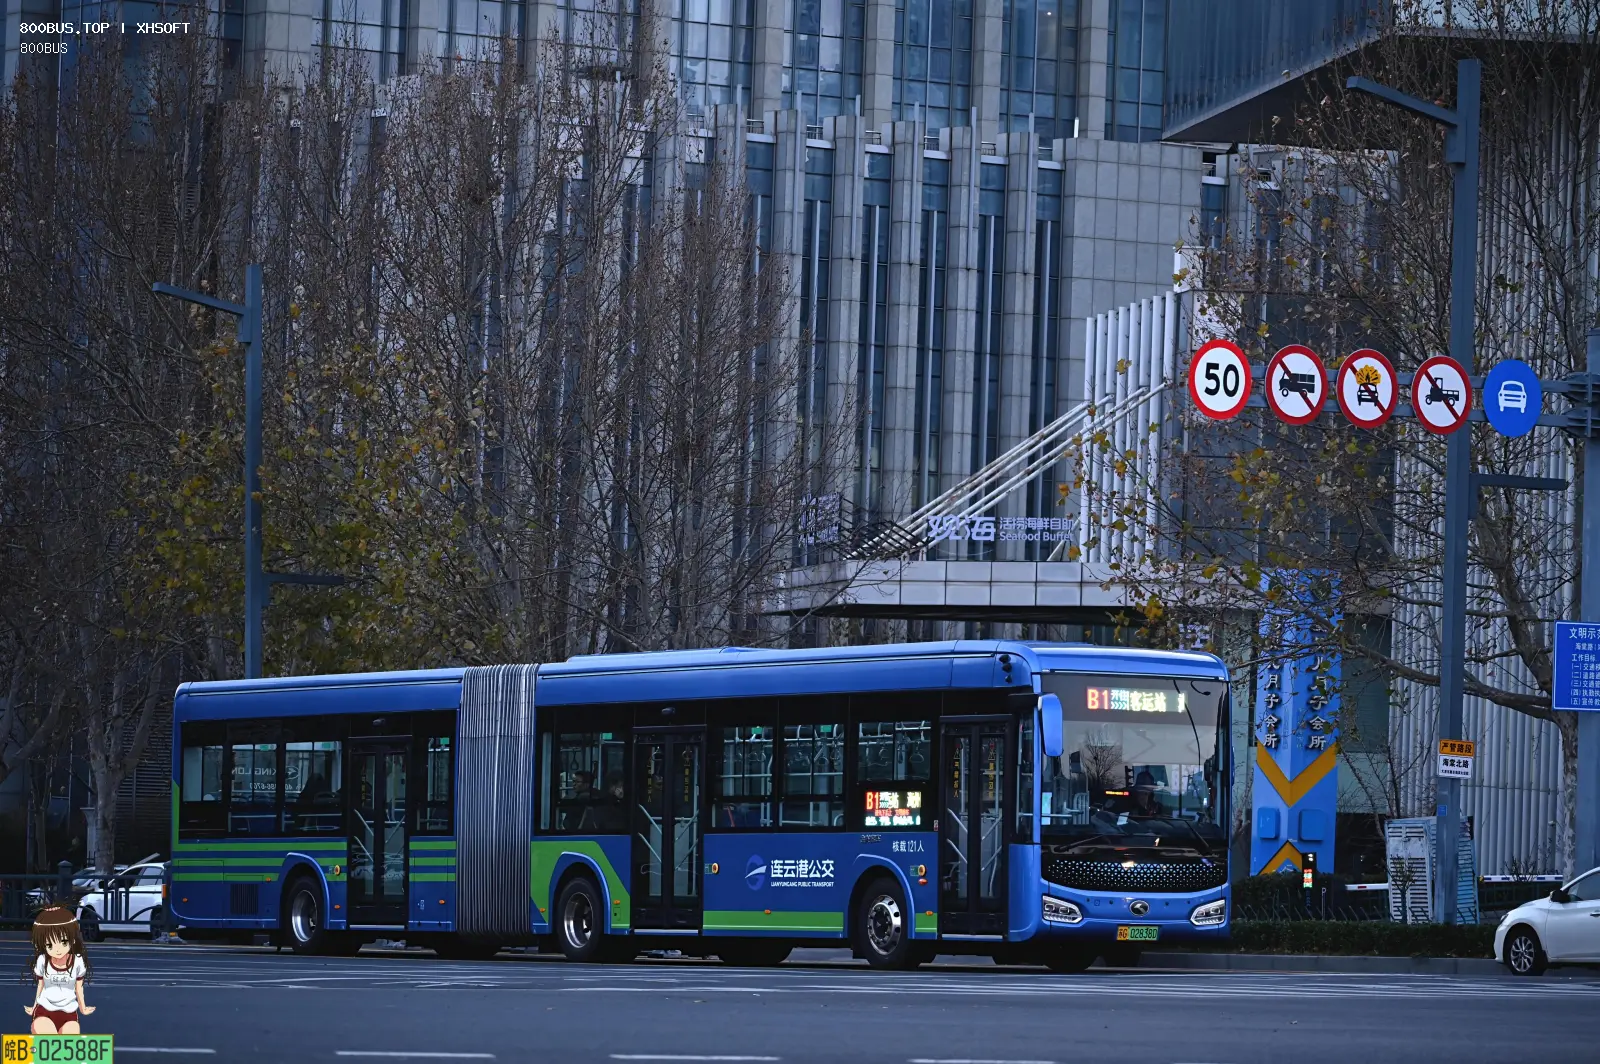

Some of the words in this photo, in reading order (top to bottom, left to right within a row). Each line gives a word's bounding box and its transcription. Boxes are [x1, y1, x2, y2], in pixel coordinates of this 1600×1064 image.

[1204, 361, 1240, 398] 50
[927, 513, 996, 542] 观海
[999, 531, 1040, 541] Seafood
[1042, 531, 1074, 541] Buffet
[1569, 627, 1600, 640] 文明示
[1087, 688, 1108, 709] B1
[1441, 742, 1472, 754] 严管路段
[1442, 758, 1469, 768] 海棠北路
[866, 791, 879, 809] B1
[892, 840, 925, 852] 核载121人
[770, 859, 834, 878] 连云港公交
